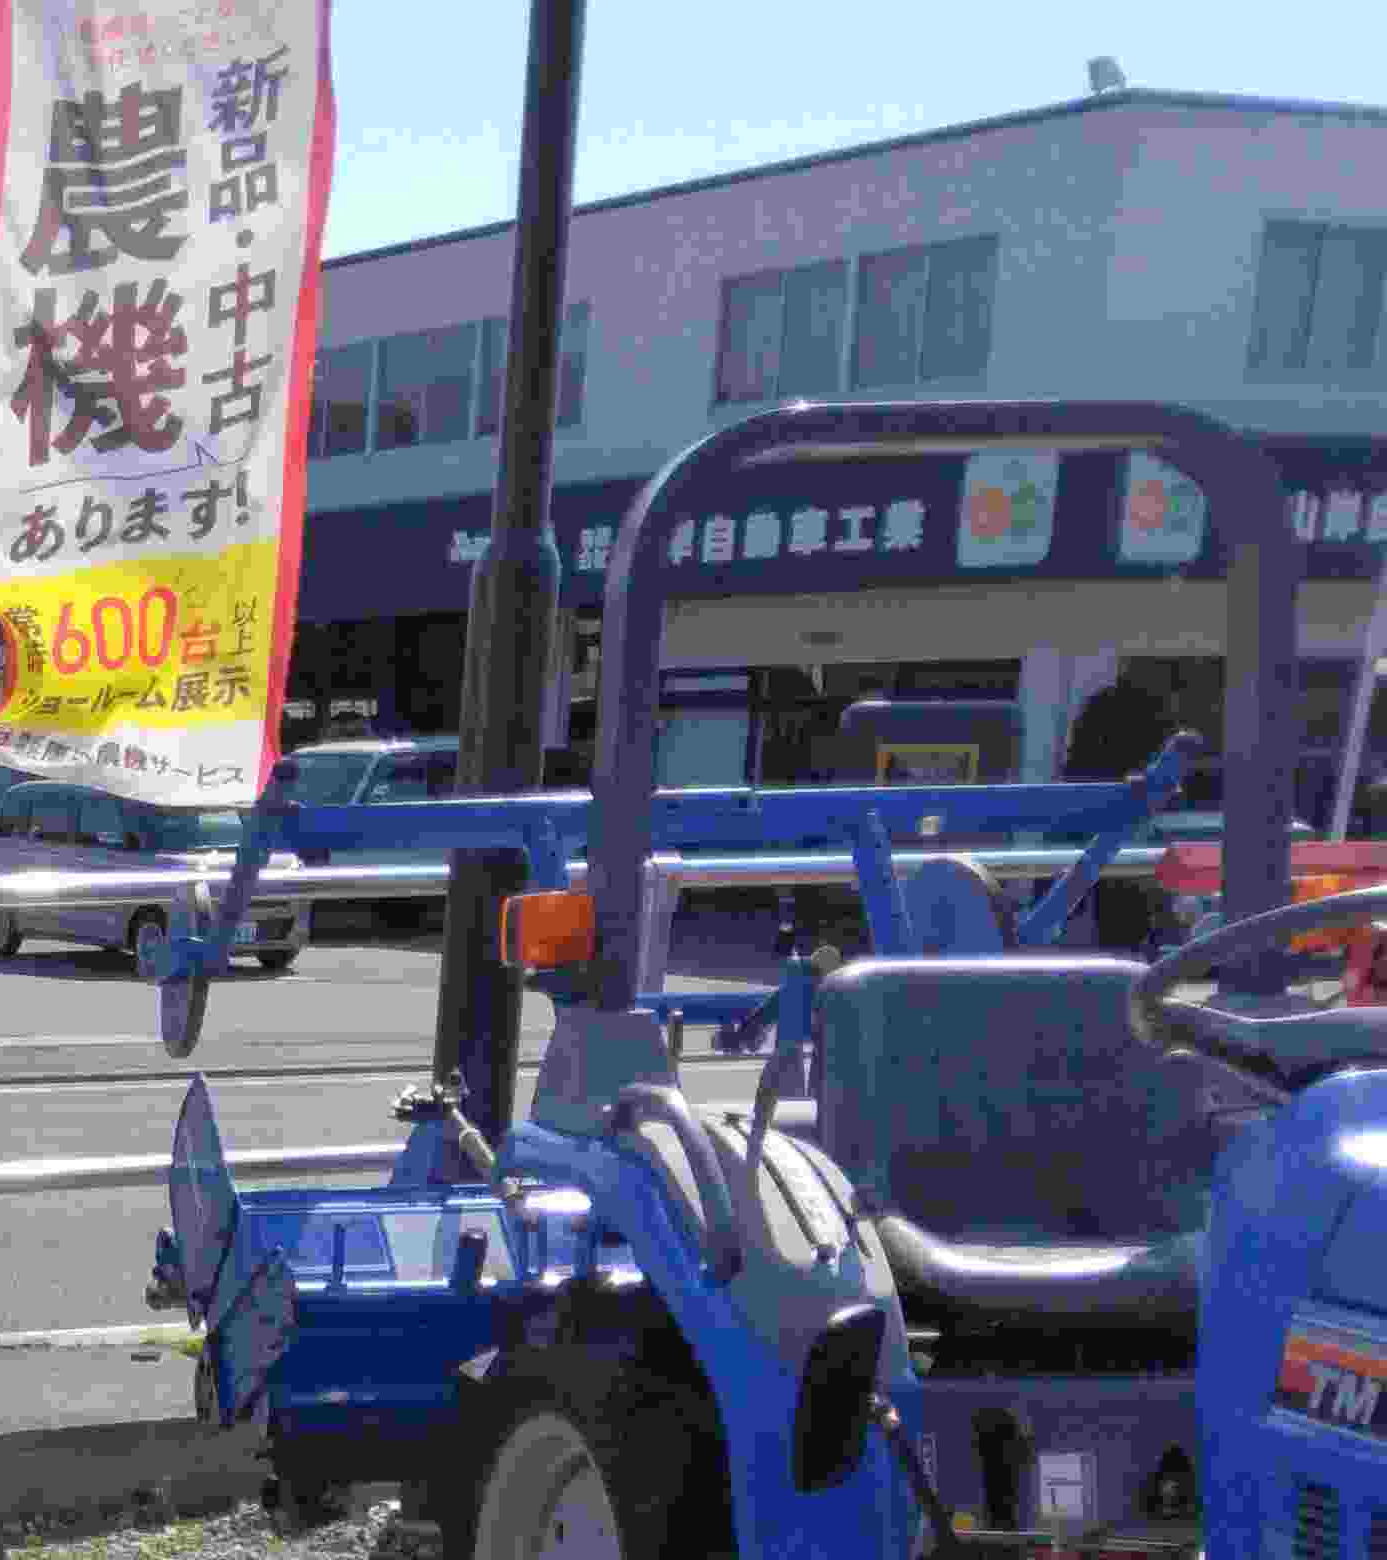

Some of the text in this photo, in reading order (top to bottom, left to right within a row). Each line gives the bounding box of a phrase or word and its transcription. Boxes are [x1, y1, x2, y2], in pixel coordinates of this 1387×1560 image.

[9, 80, 191, 467] 農機
[201, 44, 289, 438] 新品・中古
[9, 472, 252, 563] あります!
